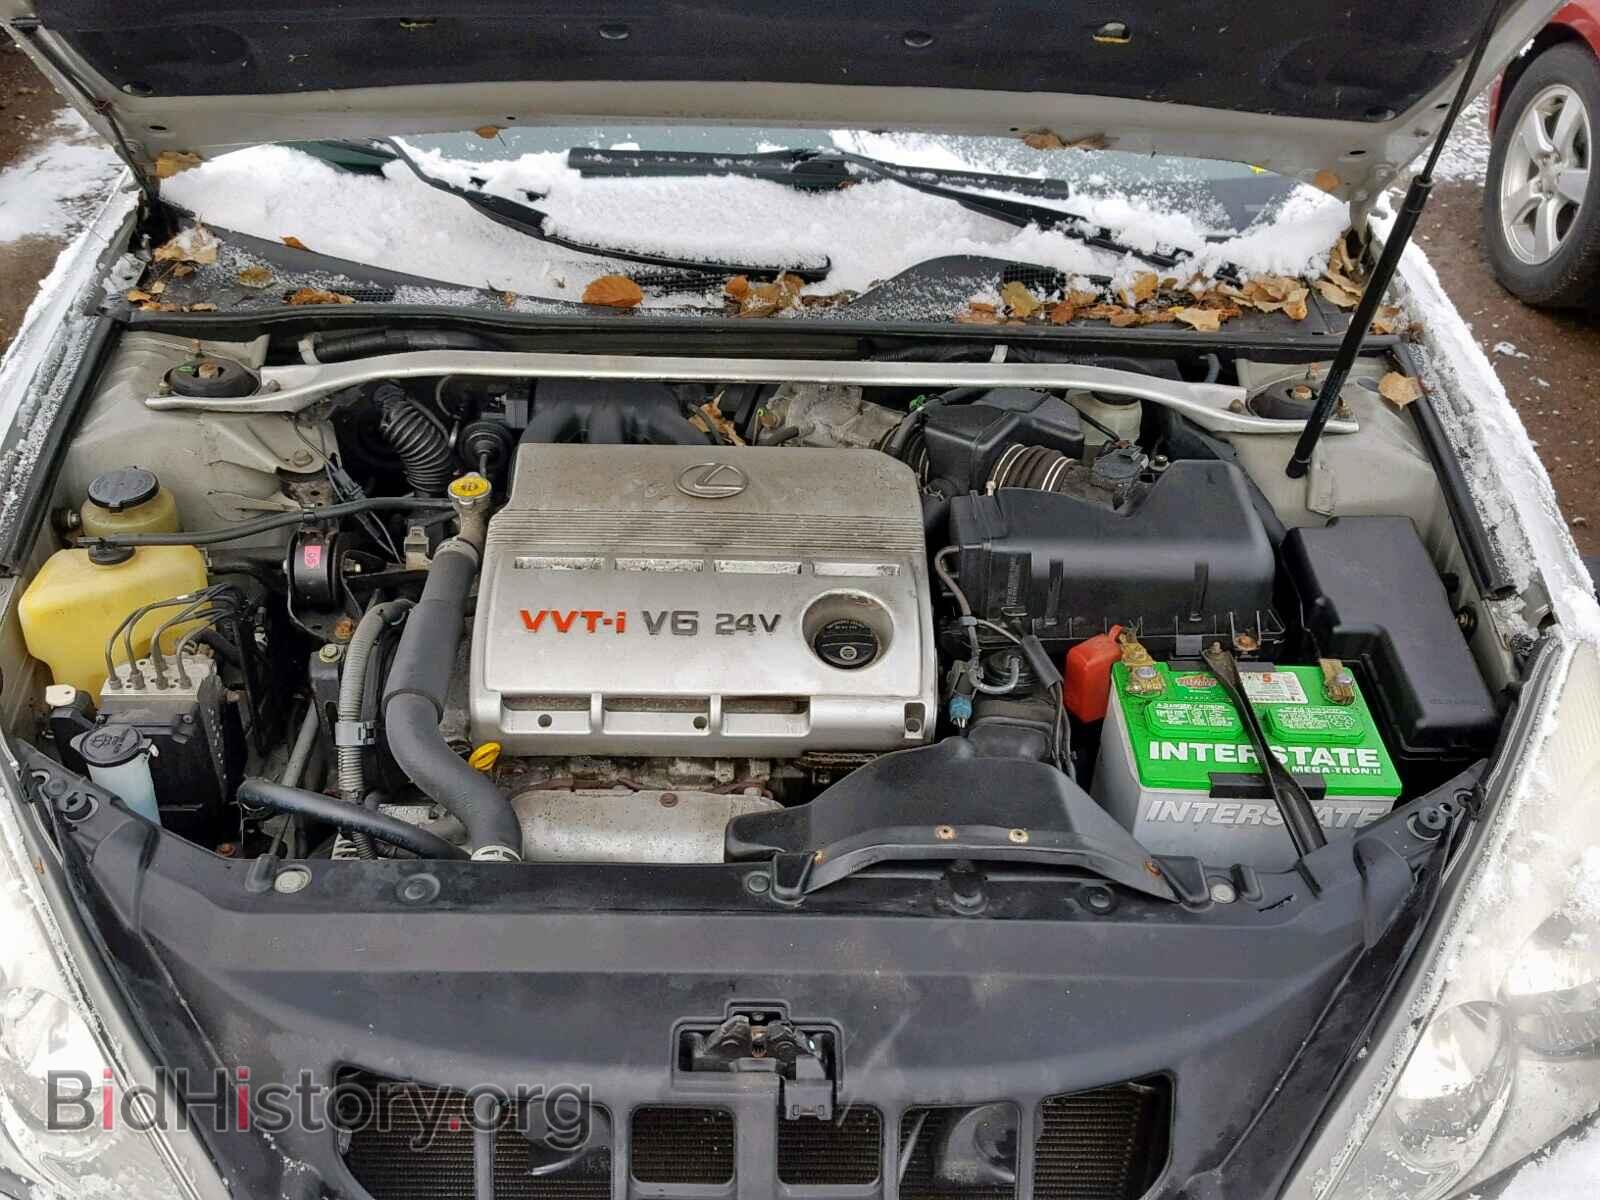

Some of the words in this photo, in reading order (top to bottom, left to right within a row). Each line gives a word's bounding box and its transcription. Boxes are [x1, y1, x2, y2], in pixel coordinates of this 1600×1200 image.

[520, 610, 626, 633] VVT-i
[641, 610, 699, 636] V6
[715, 613, 781, 636] 24V
[1149, 741, 1381, 768] INTERSTATE
